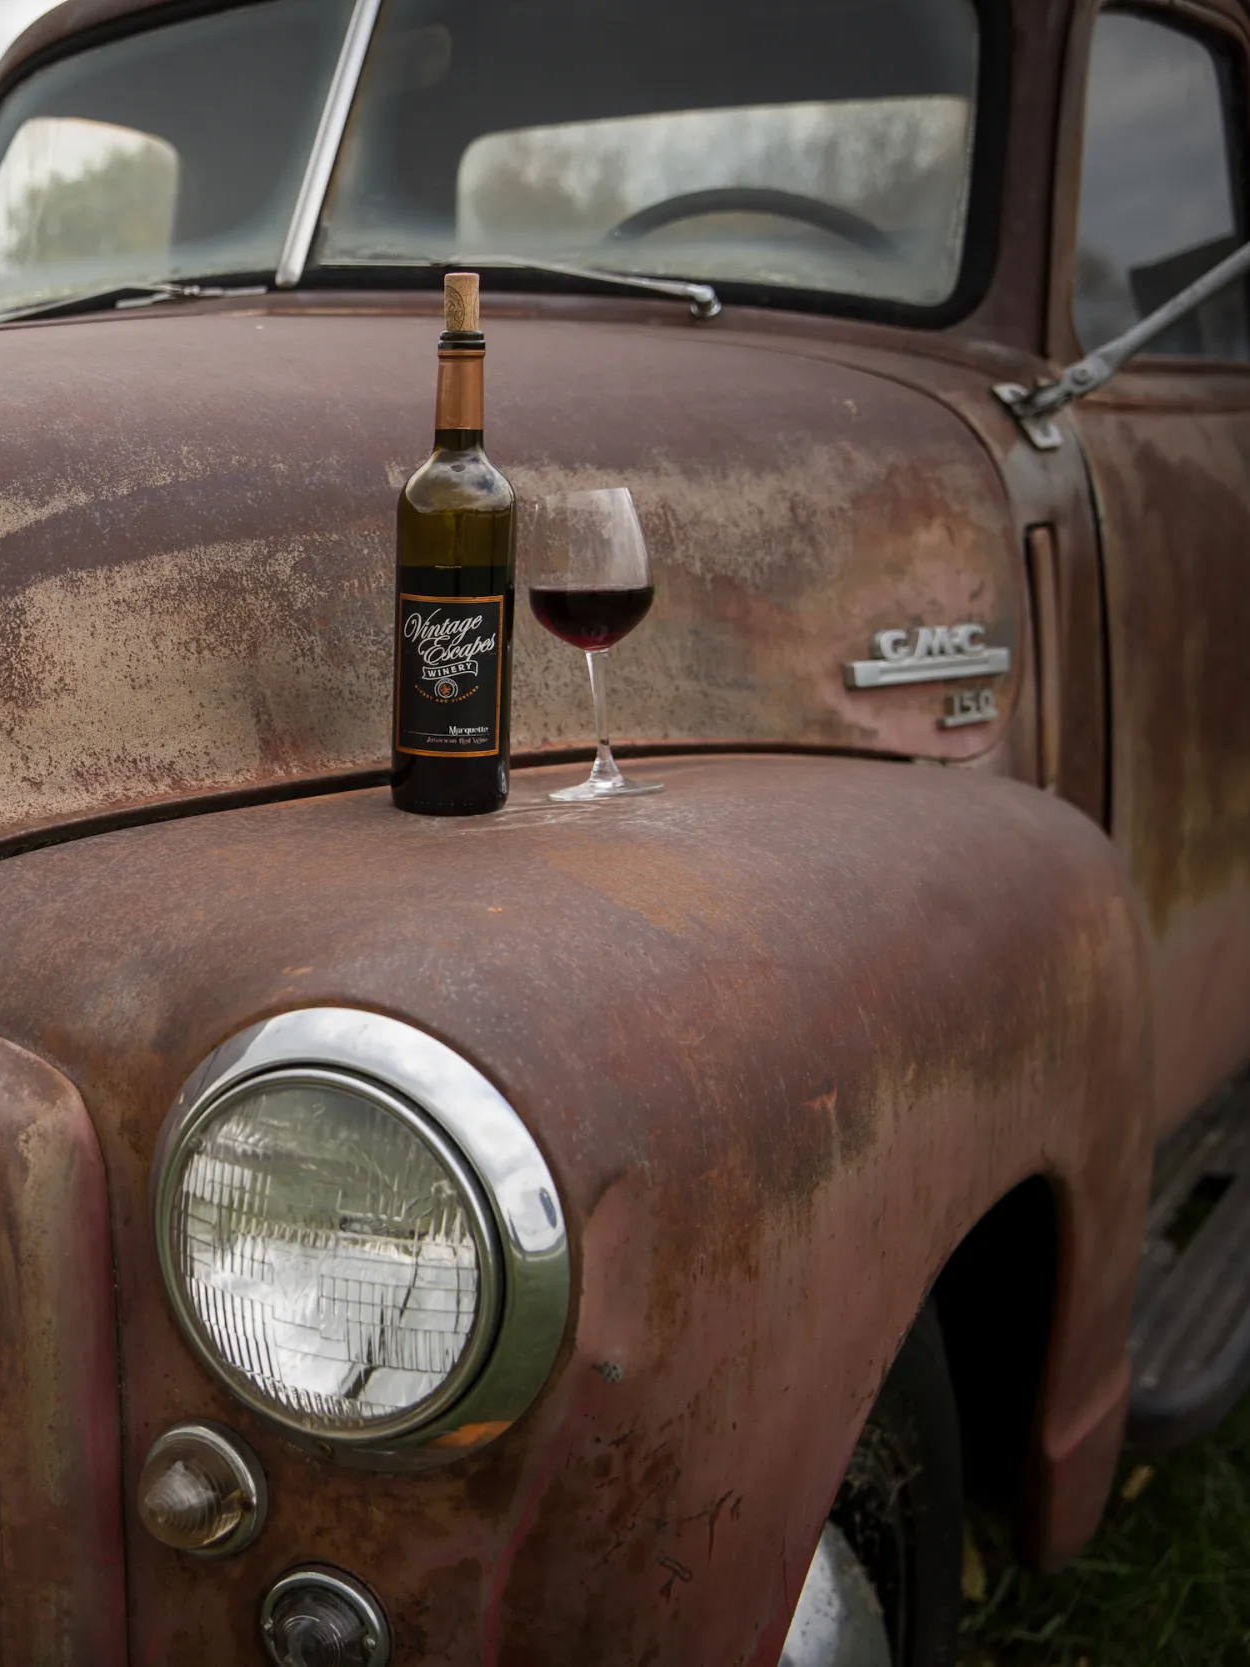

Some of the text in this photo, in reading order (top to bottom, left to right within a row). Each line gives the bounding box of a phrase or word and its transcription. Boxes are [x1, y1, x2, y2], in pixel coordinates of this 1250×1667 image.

[404, 608, 482, 646] Vintage
[878, 624, 986, 661] GMC
[418, 633, 496, 665] Escapes
[427, 662, 472, 678] WINERY
[449, 725, 489, 736] Marquette
